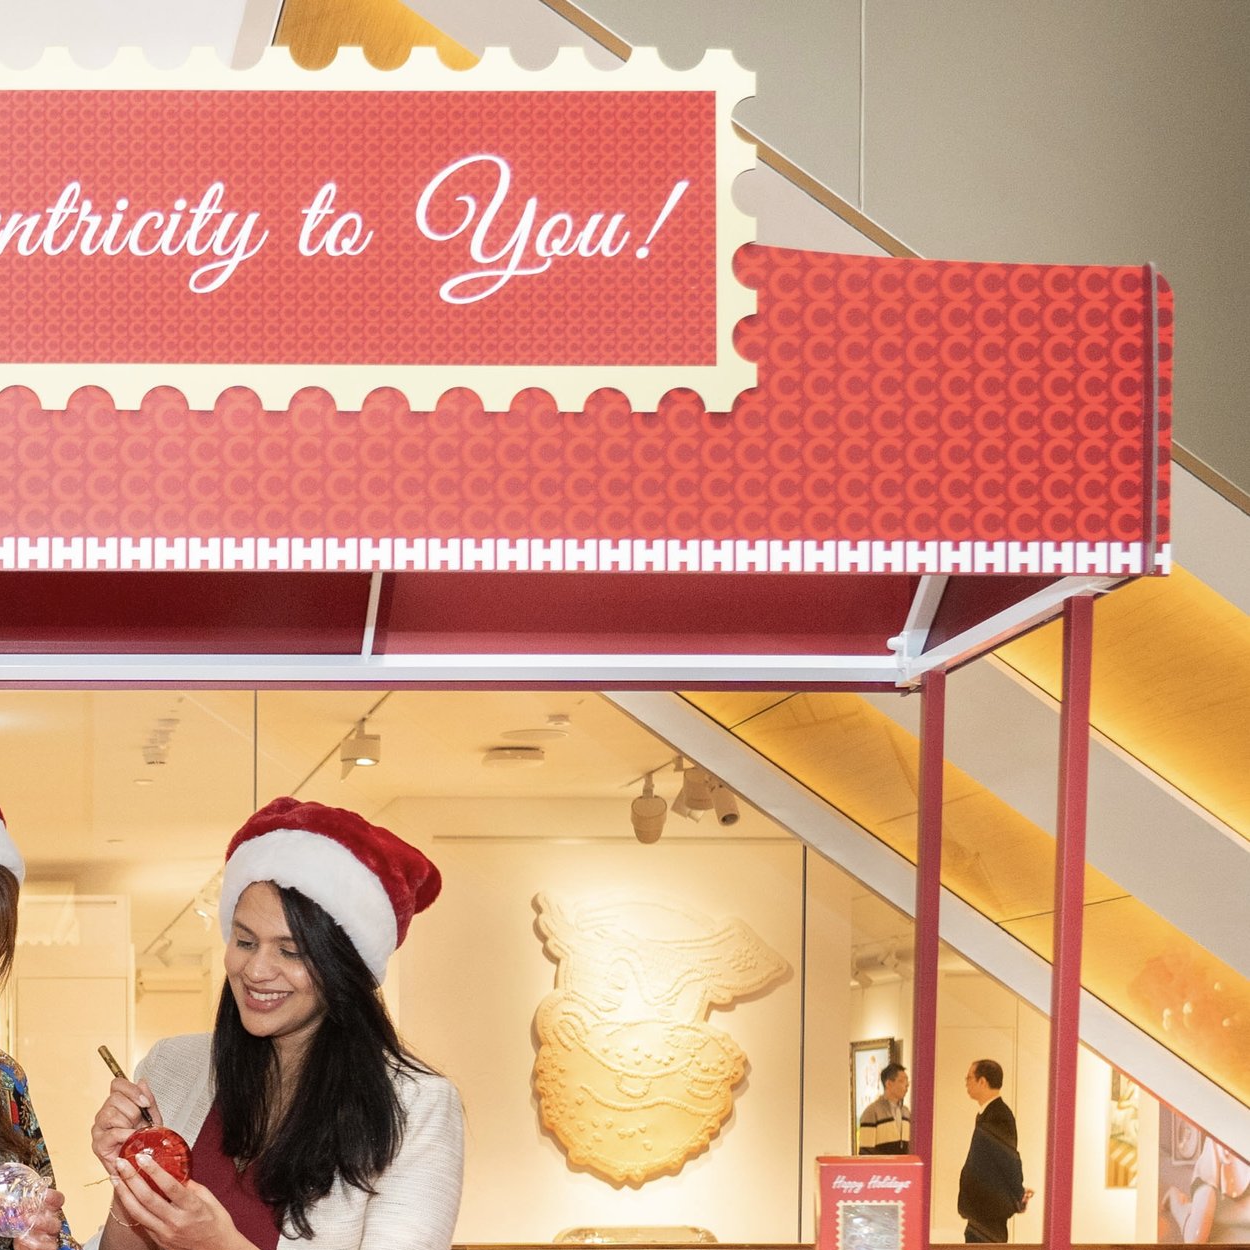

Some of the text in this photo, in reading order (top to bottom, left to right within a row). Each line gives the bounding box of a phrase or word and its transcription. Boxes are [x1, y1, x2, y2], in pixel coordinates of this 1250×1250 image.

[297, 182, 373, 257] to
[415, 153, 690, 305] You!
[832, 1175, 912, 1193] Happy Holidays
